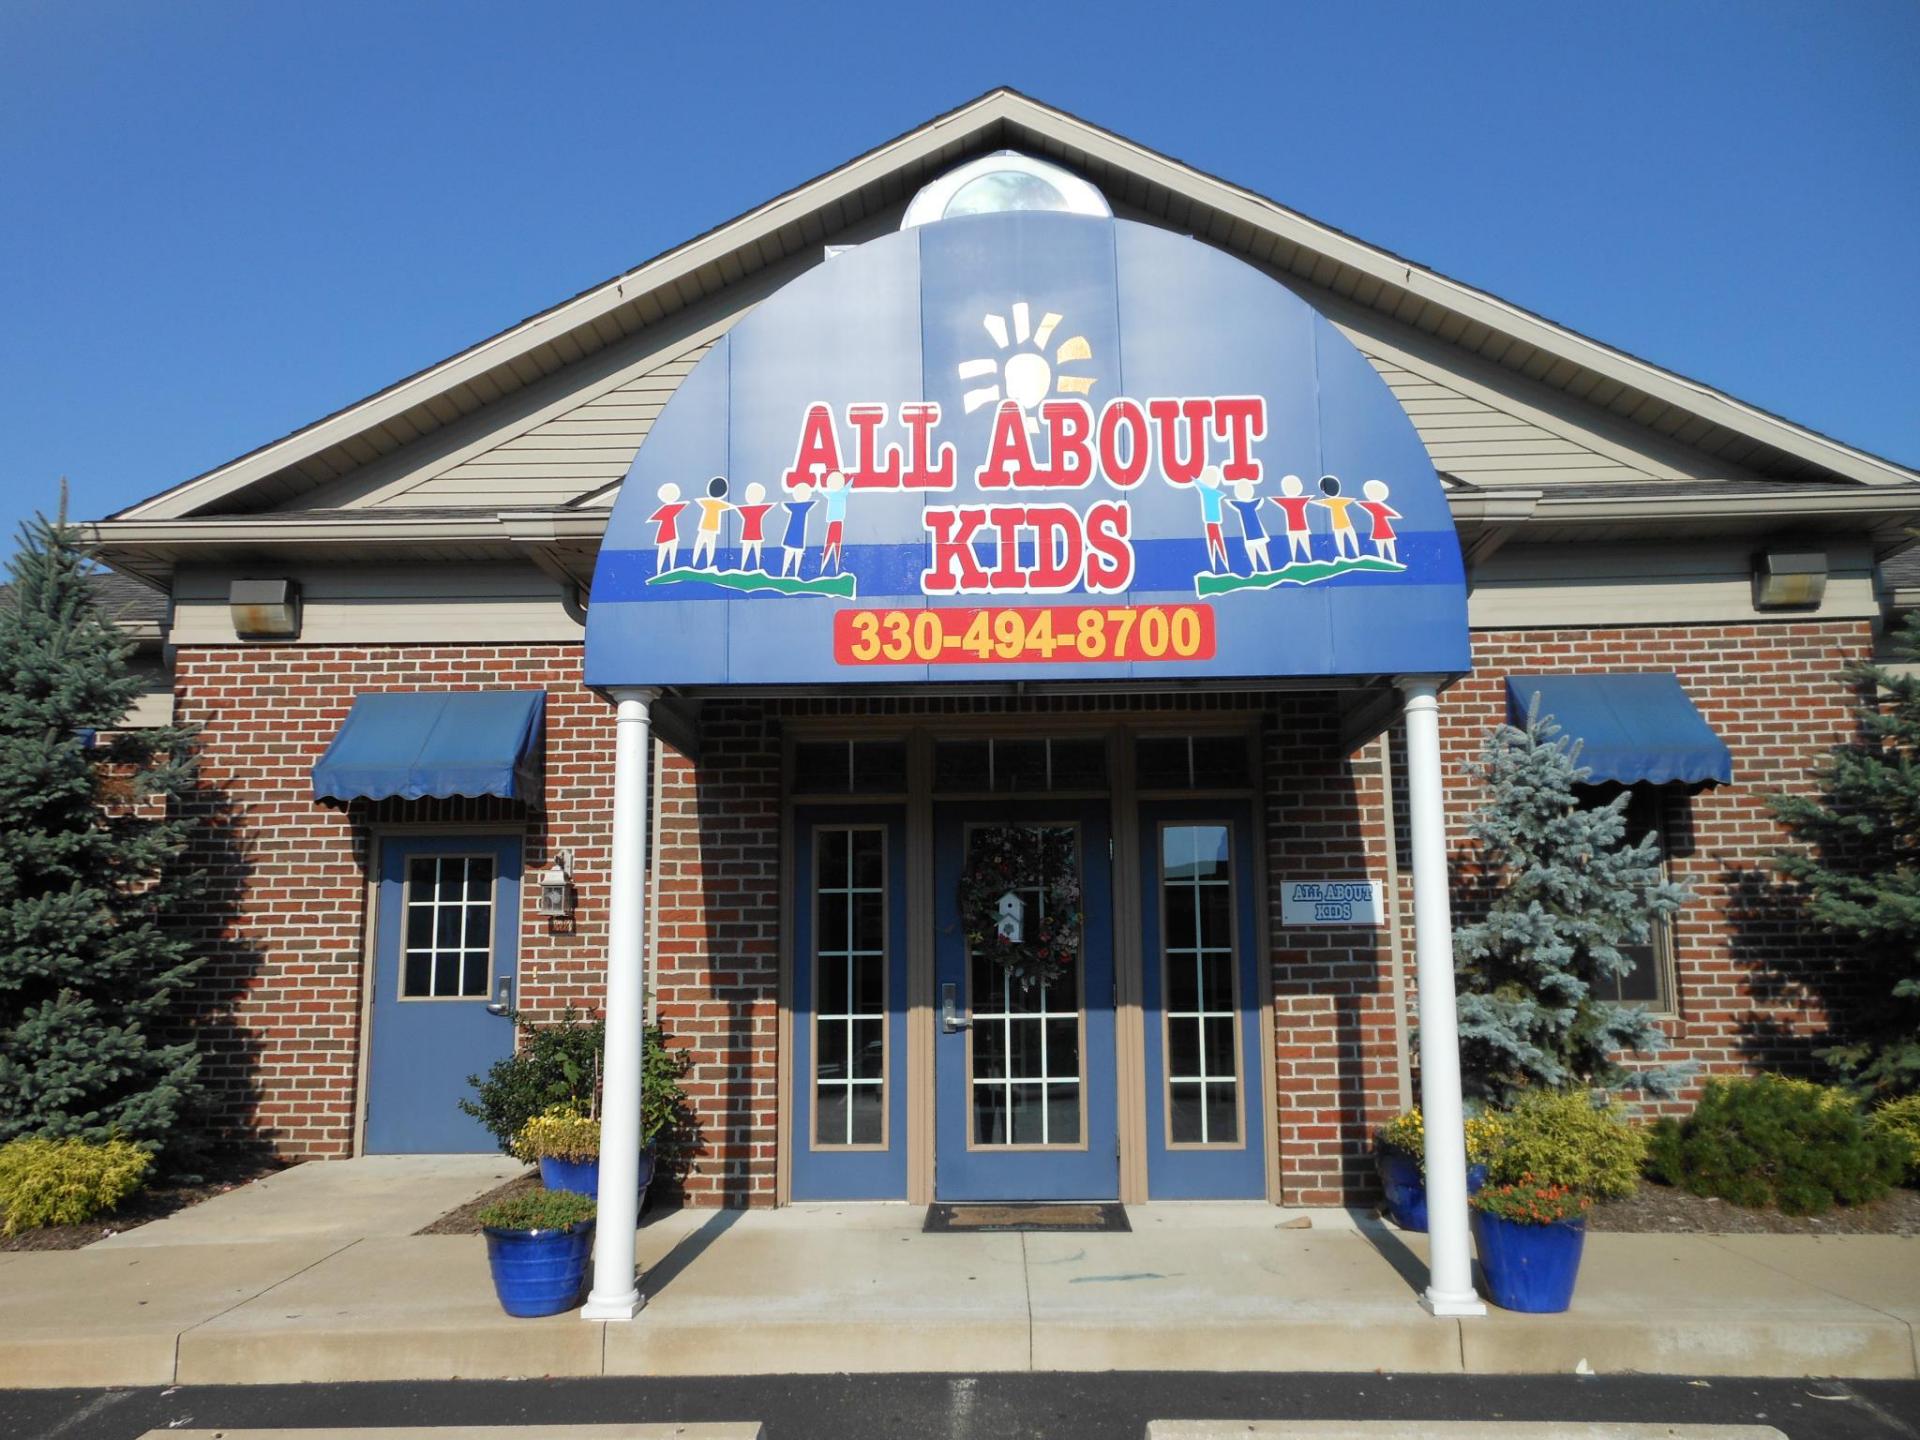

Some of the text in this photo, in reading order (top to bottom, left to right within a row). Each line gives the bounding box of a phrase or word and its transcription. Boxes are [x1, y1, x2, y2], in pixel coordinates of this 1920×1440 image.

[783, 396, 1268, 491] ALL ABOUT
[921, 500, 1134, 595] KIDS
[850, 608, 1202, 662] 330-494-8700
[1292, 883, 1373, 902] ALL ABOUT
[1315, 903, 1352, 921] KIDS
